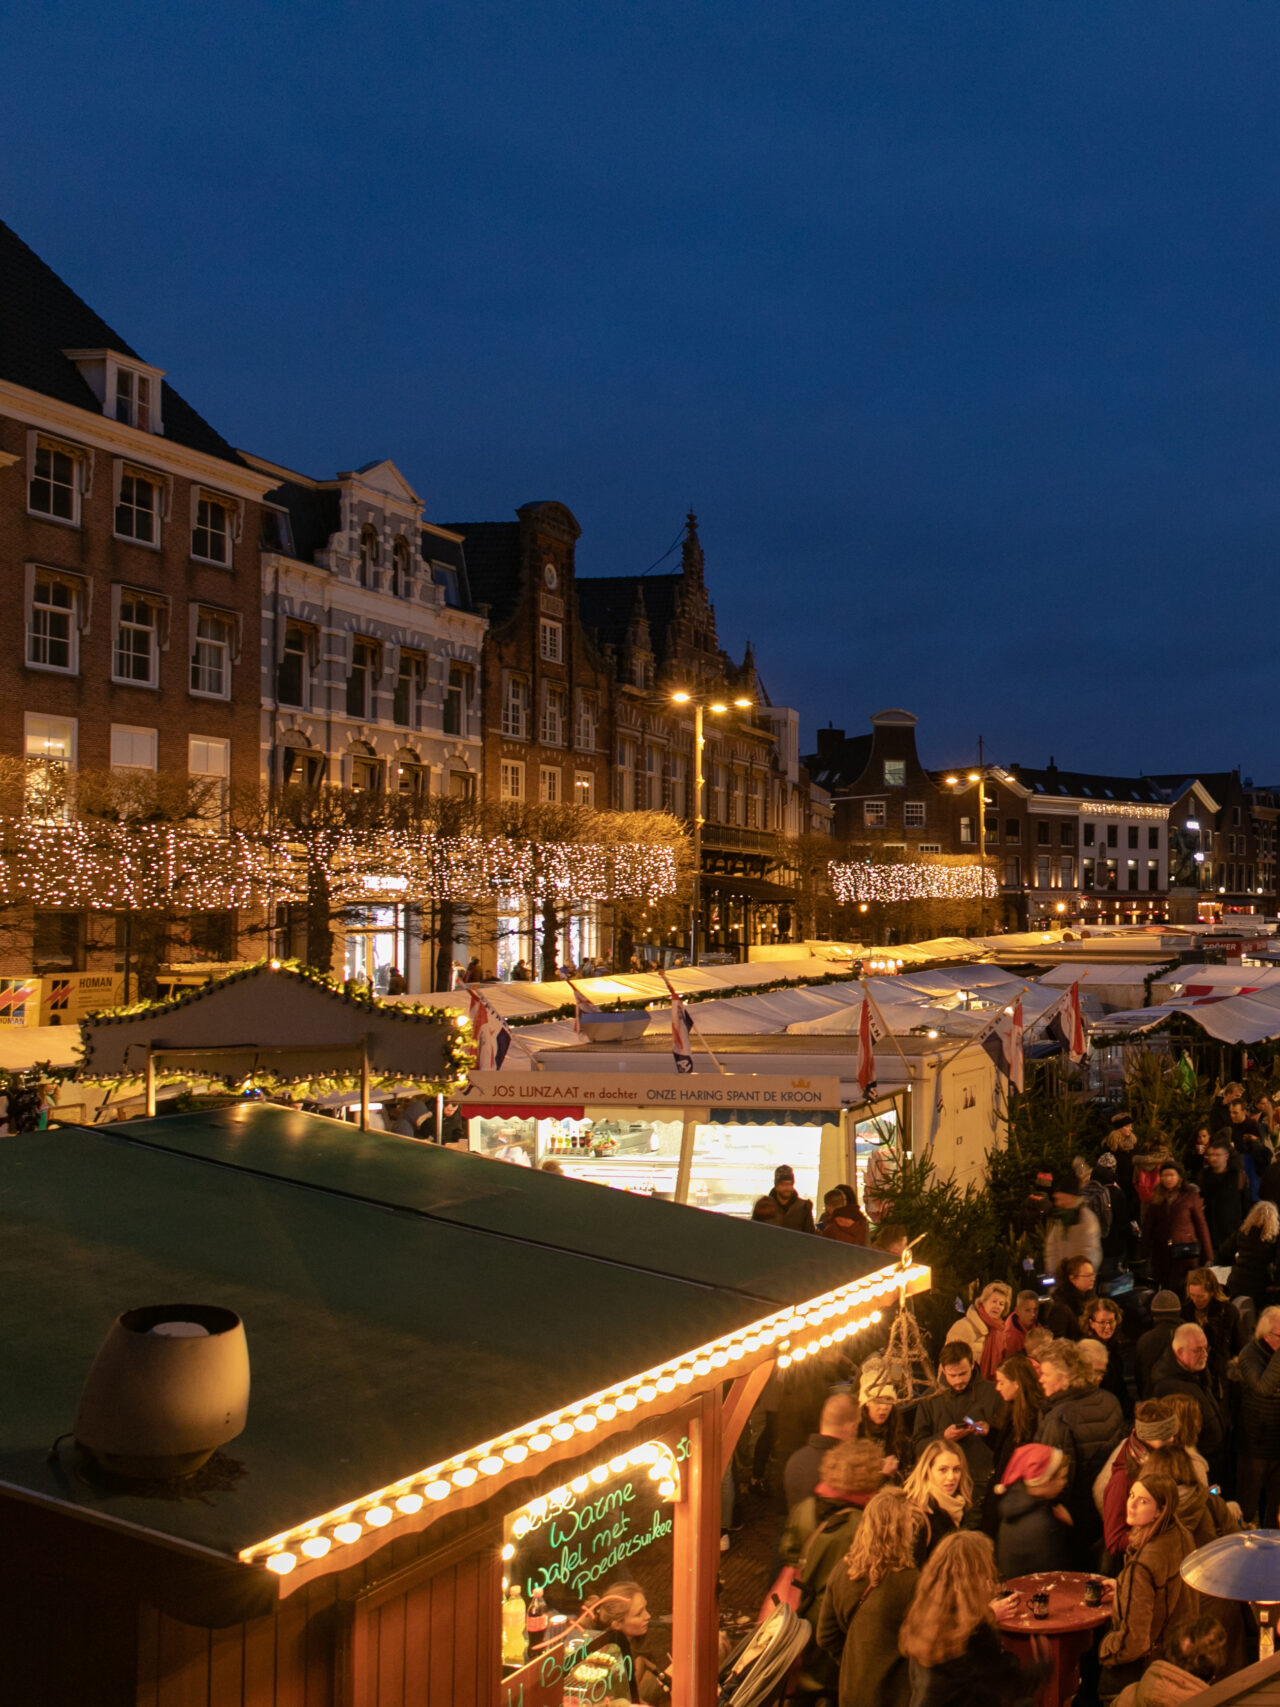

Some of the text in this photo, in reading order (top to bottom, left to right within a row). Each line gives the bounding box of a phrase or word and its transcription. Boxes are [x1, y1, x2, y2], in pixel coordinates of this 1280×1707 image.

[79, 976, 113, 988] HOMAN
[492, 1085, 638, 1099] JOS LIJNZAAT en dochter
[646, 1089, 822, 1103] ONZE HARING SPANT DE KROON
[592, 1511, 631, 1553] met
